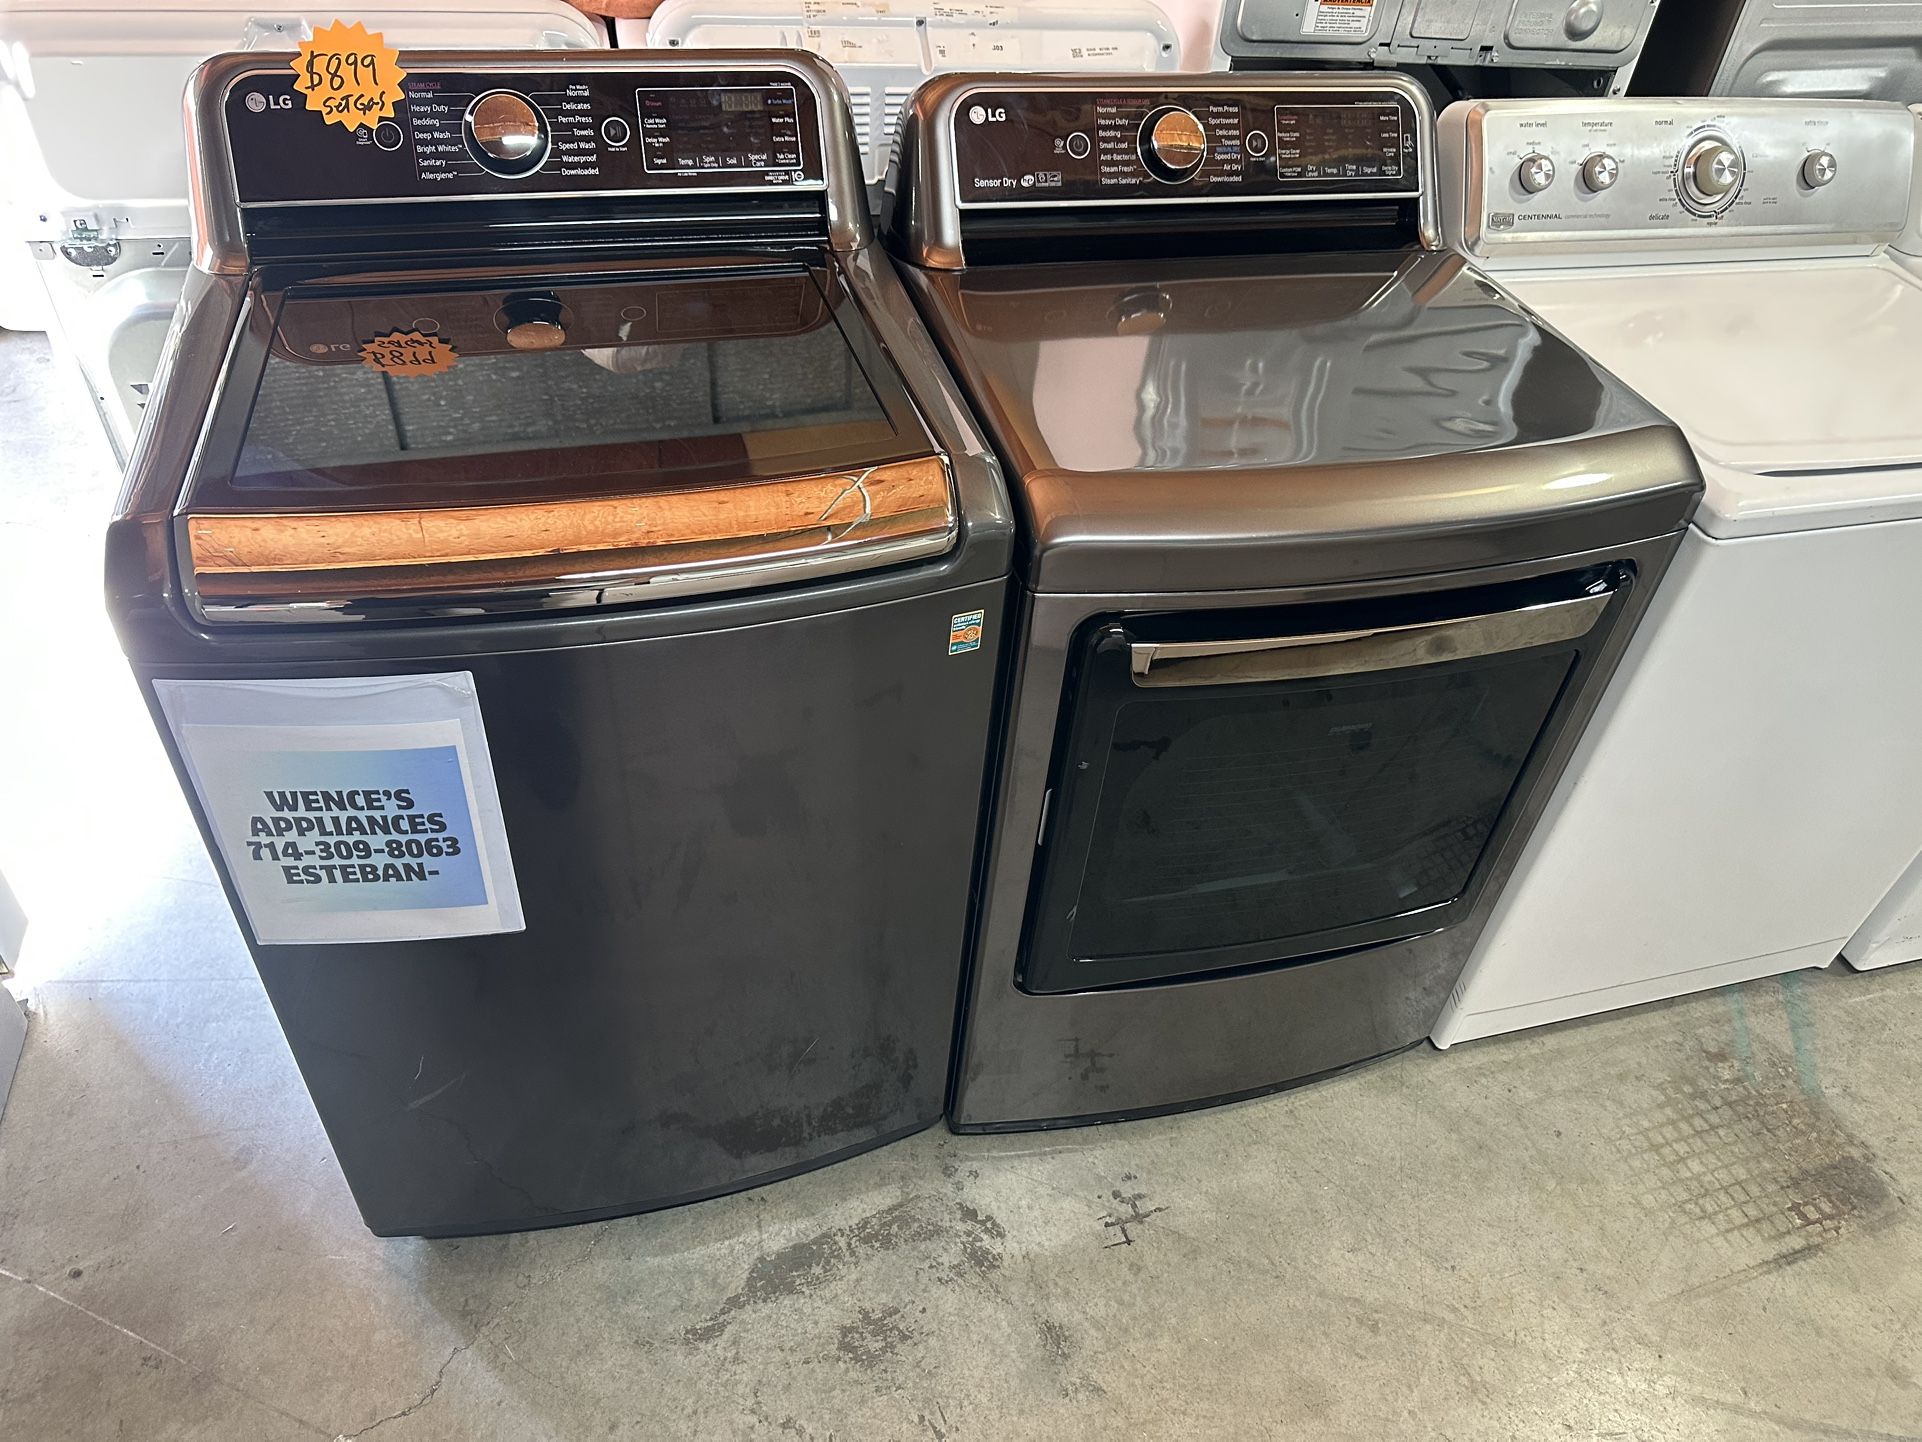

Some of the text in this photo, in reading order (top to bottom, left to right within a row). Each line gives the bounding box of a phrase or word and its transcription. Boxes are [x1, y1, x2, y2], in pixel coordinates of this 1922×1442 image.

[305, 50, 378, 91] $899
[269, 95, 292, 110] LG
[411, 105, 449, 113] Heavy Duty
[988, 109, 1006, 122] LG
[413, 118, 439, 126] Bedding
[415, 132, 431, 140] Deep
[417, 145, 436, 154] Bright
[558, 142, 578, 150] Speed
[419, 159, 446, 167] Sanitary
[562, 154, 597, 163] Waterproof
[561, 167, 599, 175] Downloaded
[975, 178, 1001, 188] Sensor
[1003, 177, 1017, 189] Dry
[1518, 213, 1563, 221] CENTENNIAL
[1649, 213, 1669, 221] delicate
[954, 614, 981, 624] CERTIFIED
[263, 788, 415, 812] WENCE'S
[251, 812, 447, 837] APPLIANCES
[247, 837, 461, 861] 714-309-8063
[282, 862, 440, 885] ESTEBAN-
